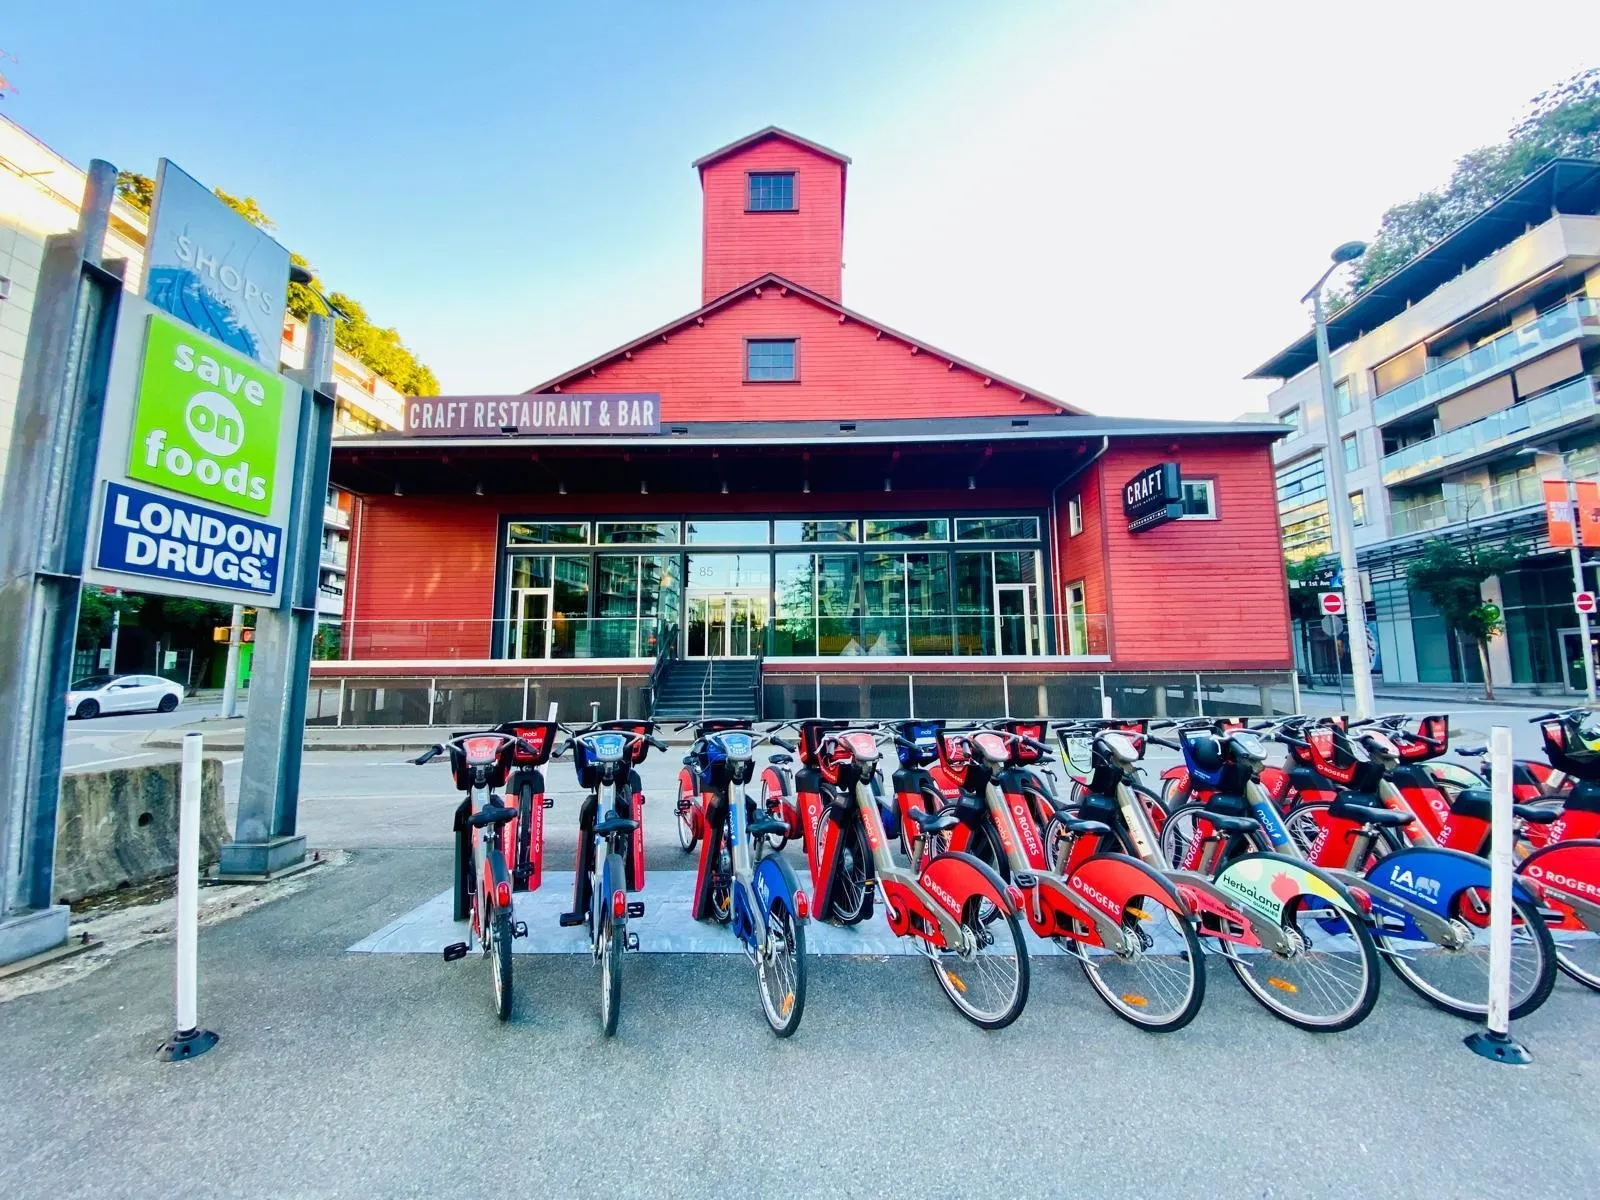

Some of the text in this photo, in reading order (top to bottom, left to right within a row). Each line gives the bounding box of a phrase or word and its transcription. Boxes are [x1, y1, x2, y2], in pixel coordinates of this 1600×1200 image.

[174, 235, 274, 316] SHOPS
[173, 344, 265, 407] save
[189, 404, 241, 446] on
[409, 400, 654, 429] CRAFT RESTAURANT & BAR
[144, 428, 267, 501] foods
[1127, 469, 1162, 505] CRAFT
[113, 493, 276, 558] LONDON
[125, 531, 263, 587] DRUGS
[699, 566, 714, 577] 85
[1272, 779, 1282, 795] mobi
[1323, 766, 1350, 780] ROGERS
[1018, 816, 1040, 856] ROGERS
[1256, 809, 1276, 833] mobi
[1184, 828, 1203, 868] ROGERS
[1307, 826, 1330, 864] ROGERS
[1223, 874, 1281, 912] HerbaLand
[1390, 865, 1414, 889] iA
[1545, 870, 1600, 898] ROGERS
[930, 881, 961, 914] ROGERS
[1082, 883, 1120, 915] ROGERS
